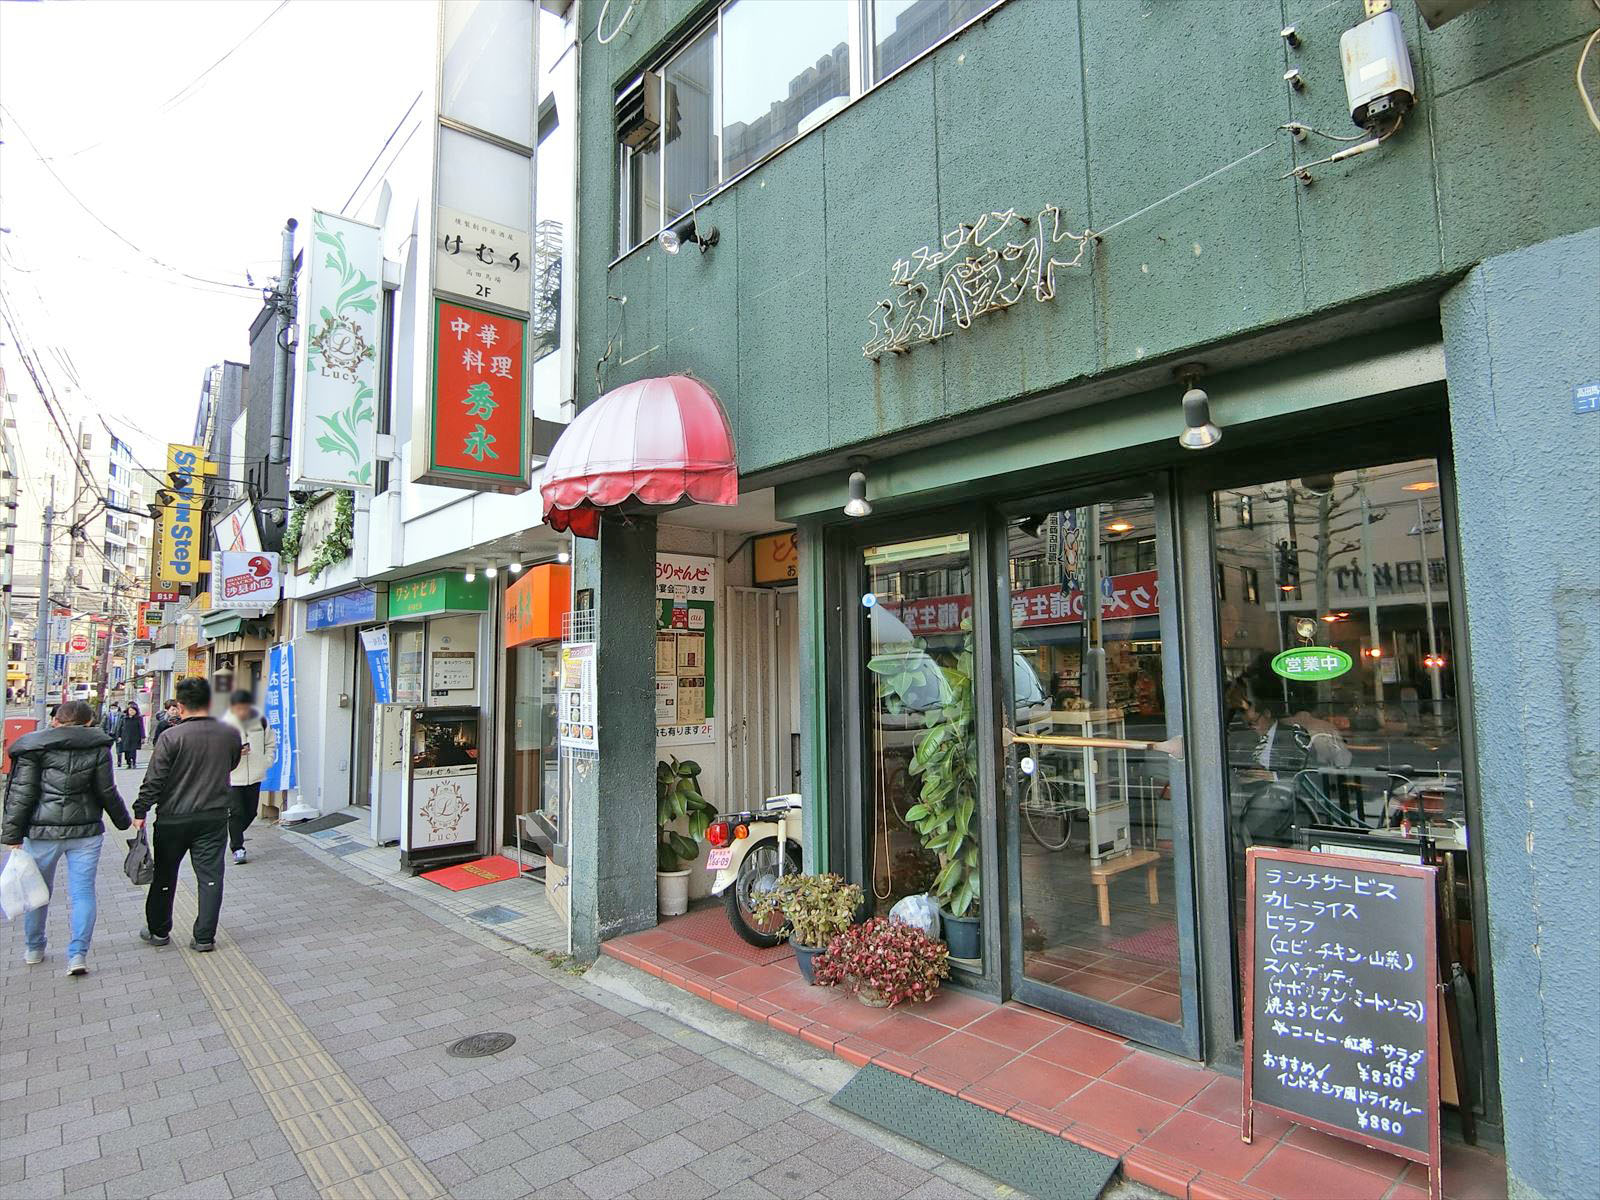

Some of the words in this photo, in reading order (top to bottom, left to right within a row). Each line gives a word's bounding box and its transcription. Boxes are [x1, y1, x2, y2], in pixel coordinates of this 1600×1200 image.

[475, 284, 492, 298] 2F
[450, 317, 500, 349] 中華
[321, 367, 359, 384] Lucy
[462, 348, 513, 380] 料理
[461, 380, 500, 463] 秀永
[168, 523, 194, 576] Step
[1285, 654, 1339, 673] 営業中
[701, 725, 713, 735] 2F
[427, 832, 460, 843] Lucy
[1265, 869, 1398, 900] ランチサービス
[1263, 890, 1359, 919] カレーライス
[1265, 911, 1316, 934] ピラフ
[1264, 995, 1344, 1023] 焼きうどん
[1385, 1060, 1416, 1081] 付き
[1355, 1107, 1403, 1135] ¥880
